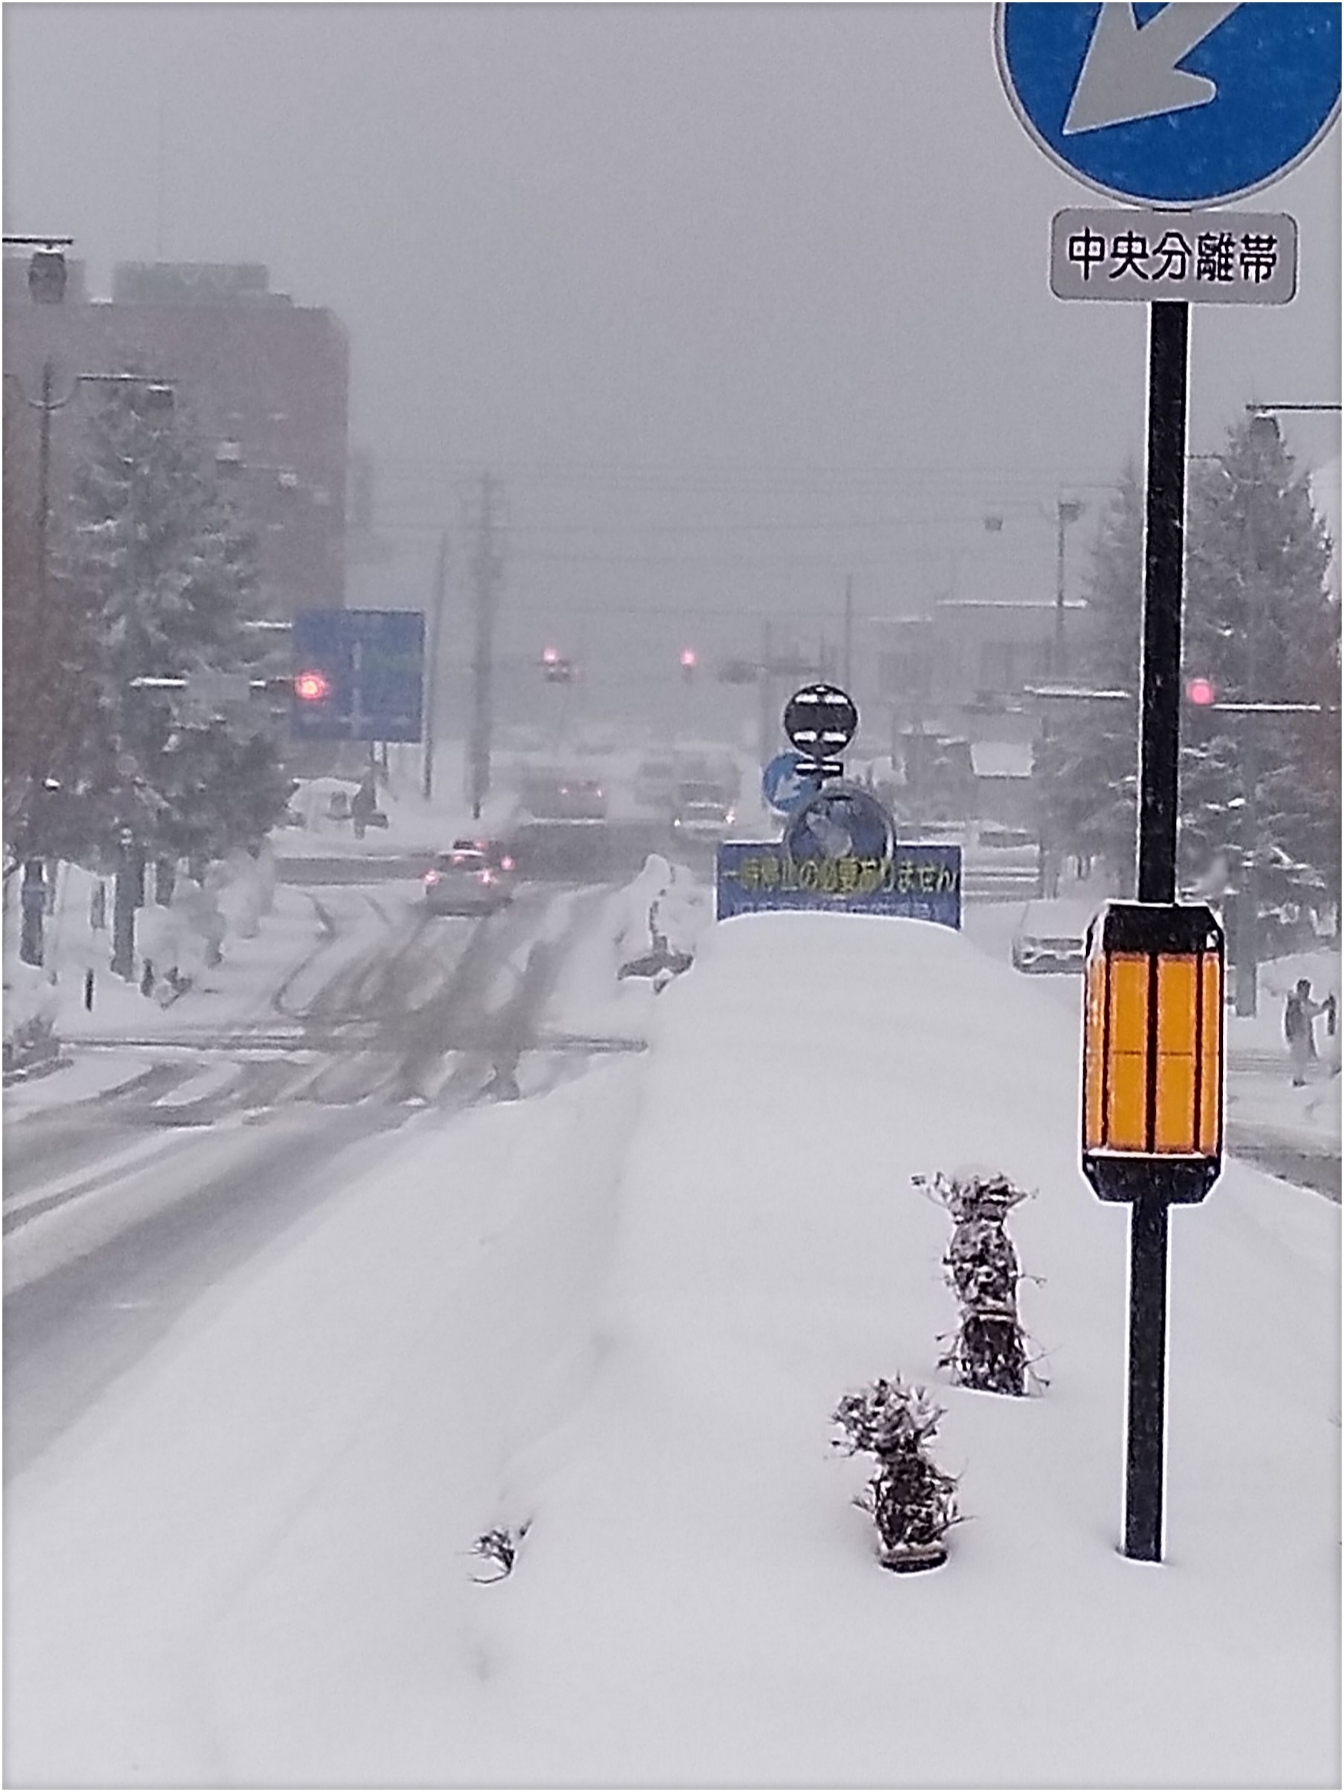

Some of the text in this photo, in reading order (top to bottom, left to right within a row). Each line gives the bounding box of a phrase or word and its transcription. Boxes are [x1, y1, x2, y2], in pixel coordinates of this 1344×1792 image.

[1068, 226, 1278, 284] 中央分離帯
